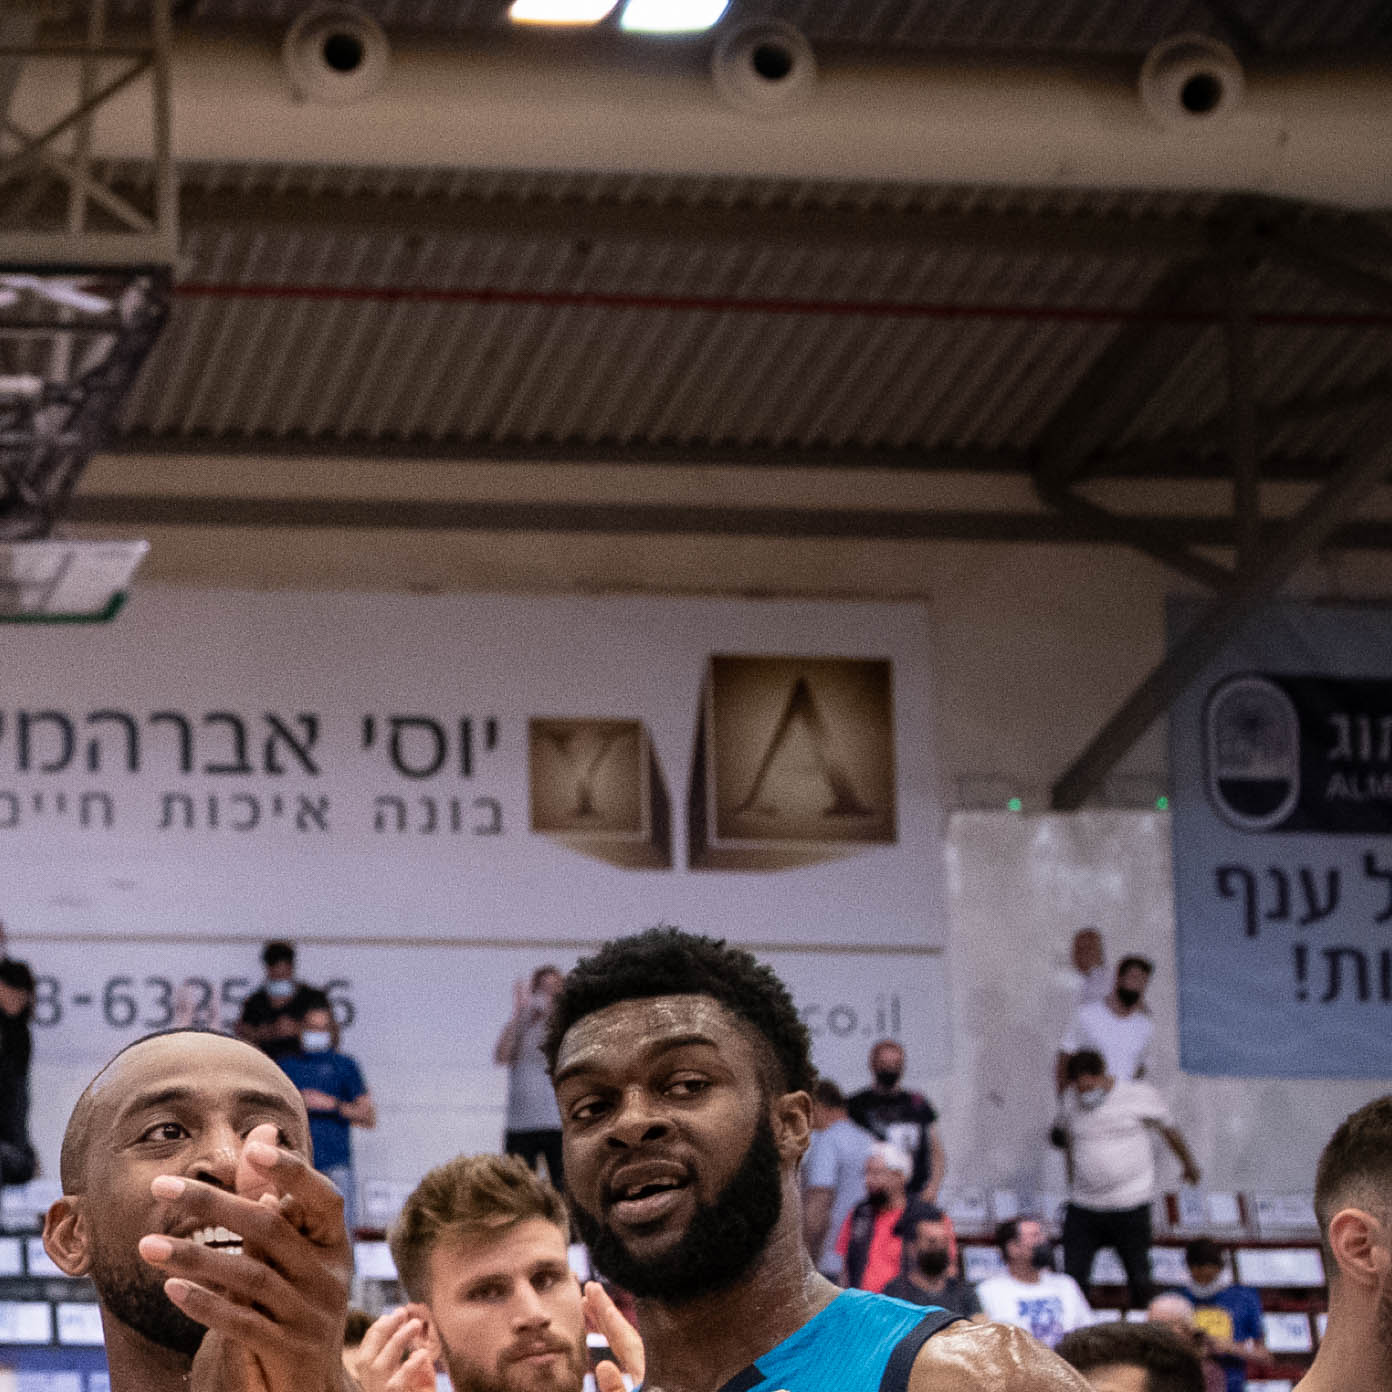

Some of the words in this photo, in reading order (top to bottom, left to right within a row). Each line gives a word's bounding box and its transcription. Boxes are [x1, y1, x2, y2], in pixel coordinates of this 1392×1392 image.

[361, 716, 499, 783] יוסי
[161, 787, 330, 834] איכות
[374, 791, 505, 836] בונה
[1216, 861, 1341, 937] ענף
